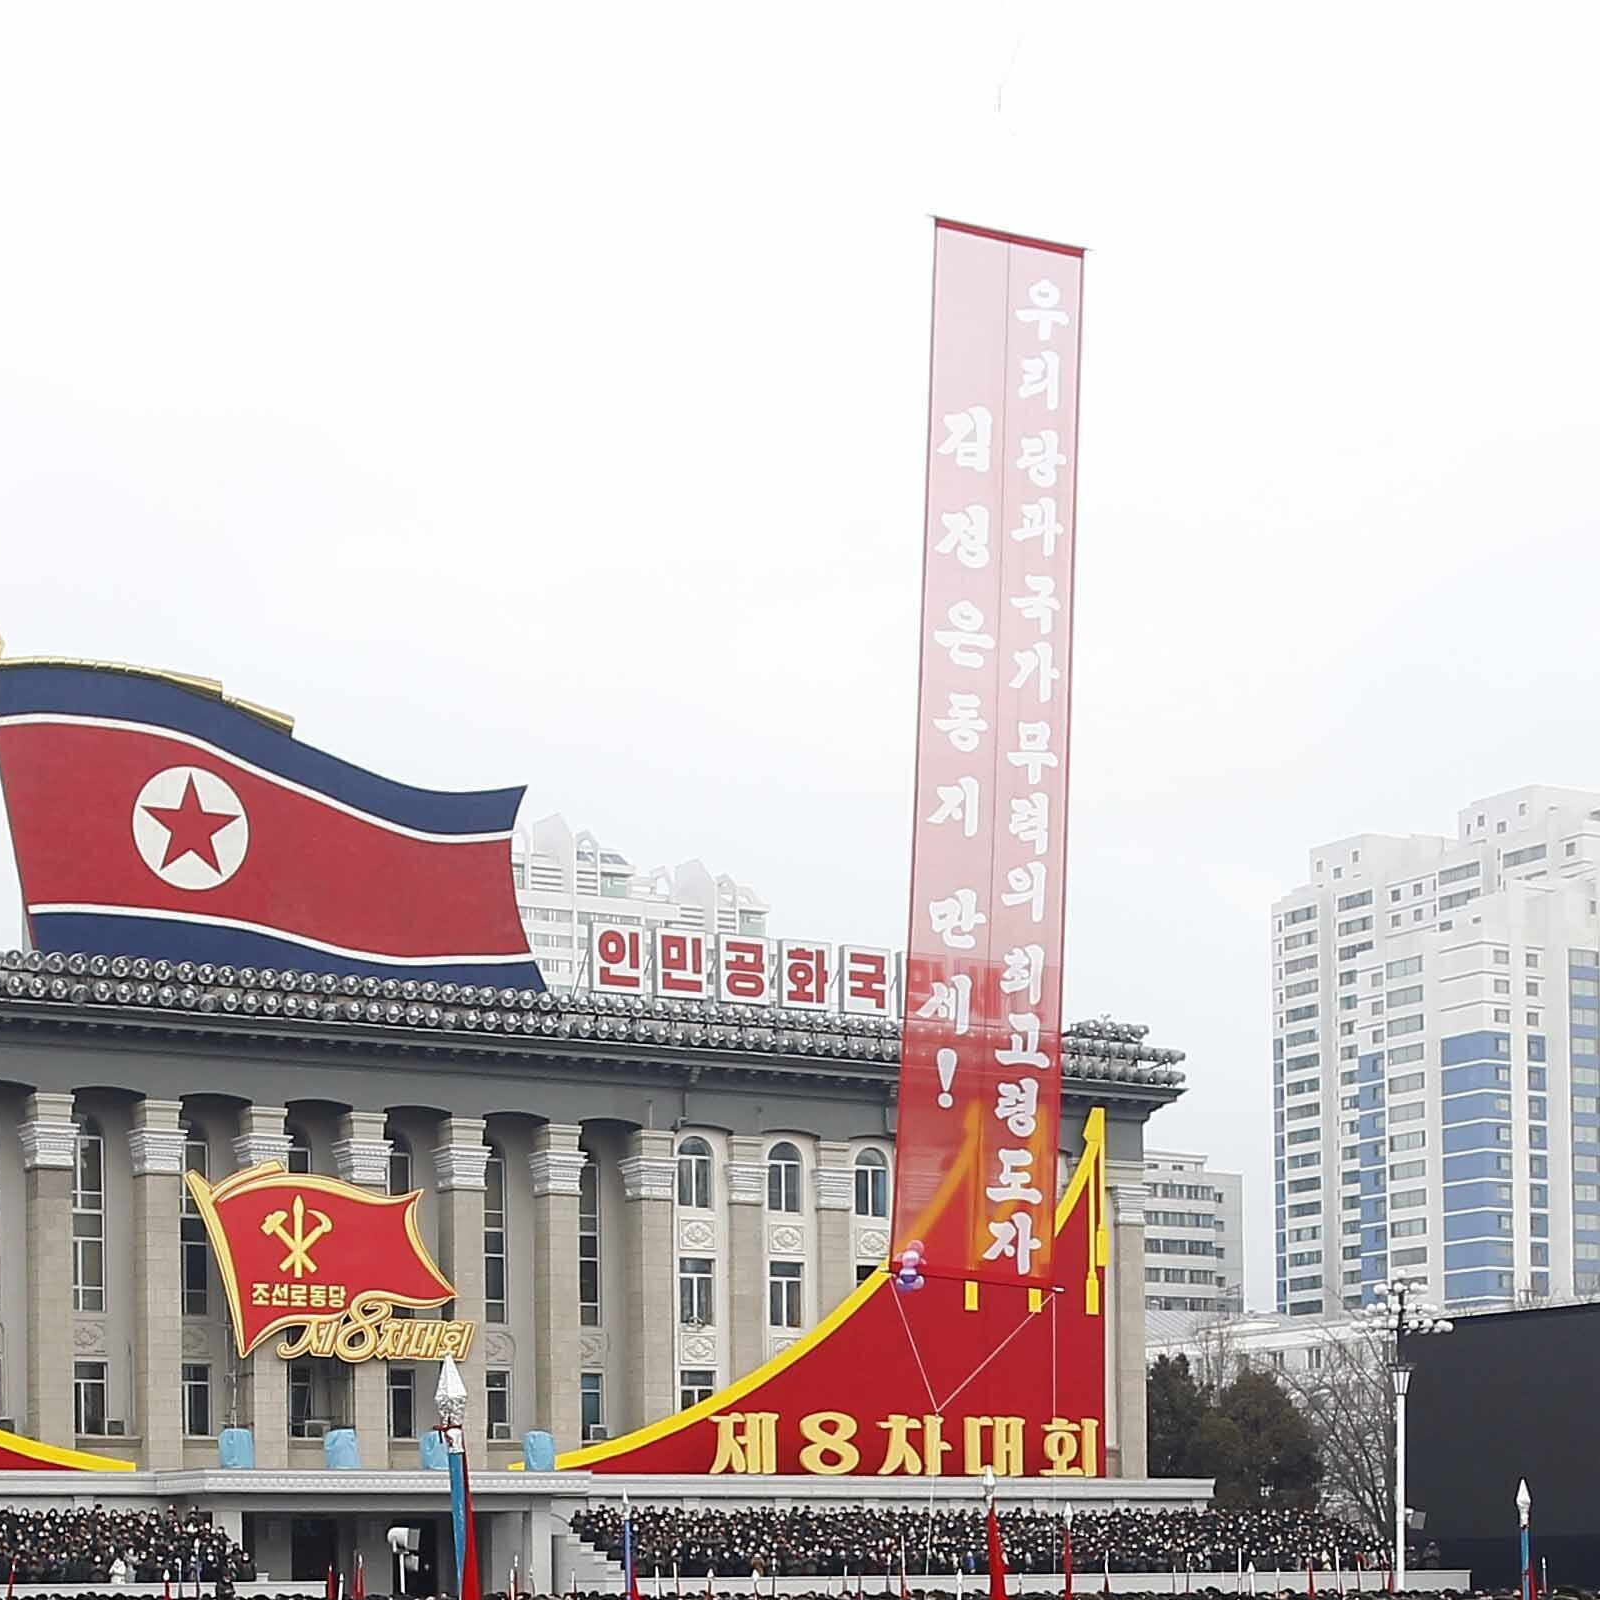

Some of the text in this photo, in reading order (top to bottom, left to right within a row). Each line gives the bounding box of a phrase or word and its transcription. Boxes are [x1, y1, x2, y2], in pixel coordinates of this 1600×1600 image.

[915, 405, 996, 1109] 김정은동지 만세!
[982, 278, 1070, 1277] 우리 당과 국가 무력의 최고령도자
[598, 929, 887, 1010] 인민공화국
[252, 1283, 346, 1307] 조선로동당
[277, 1301, 475, 1363] 제8차대회
[708, 1411, 1099, 1478] 제8차대회
